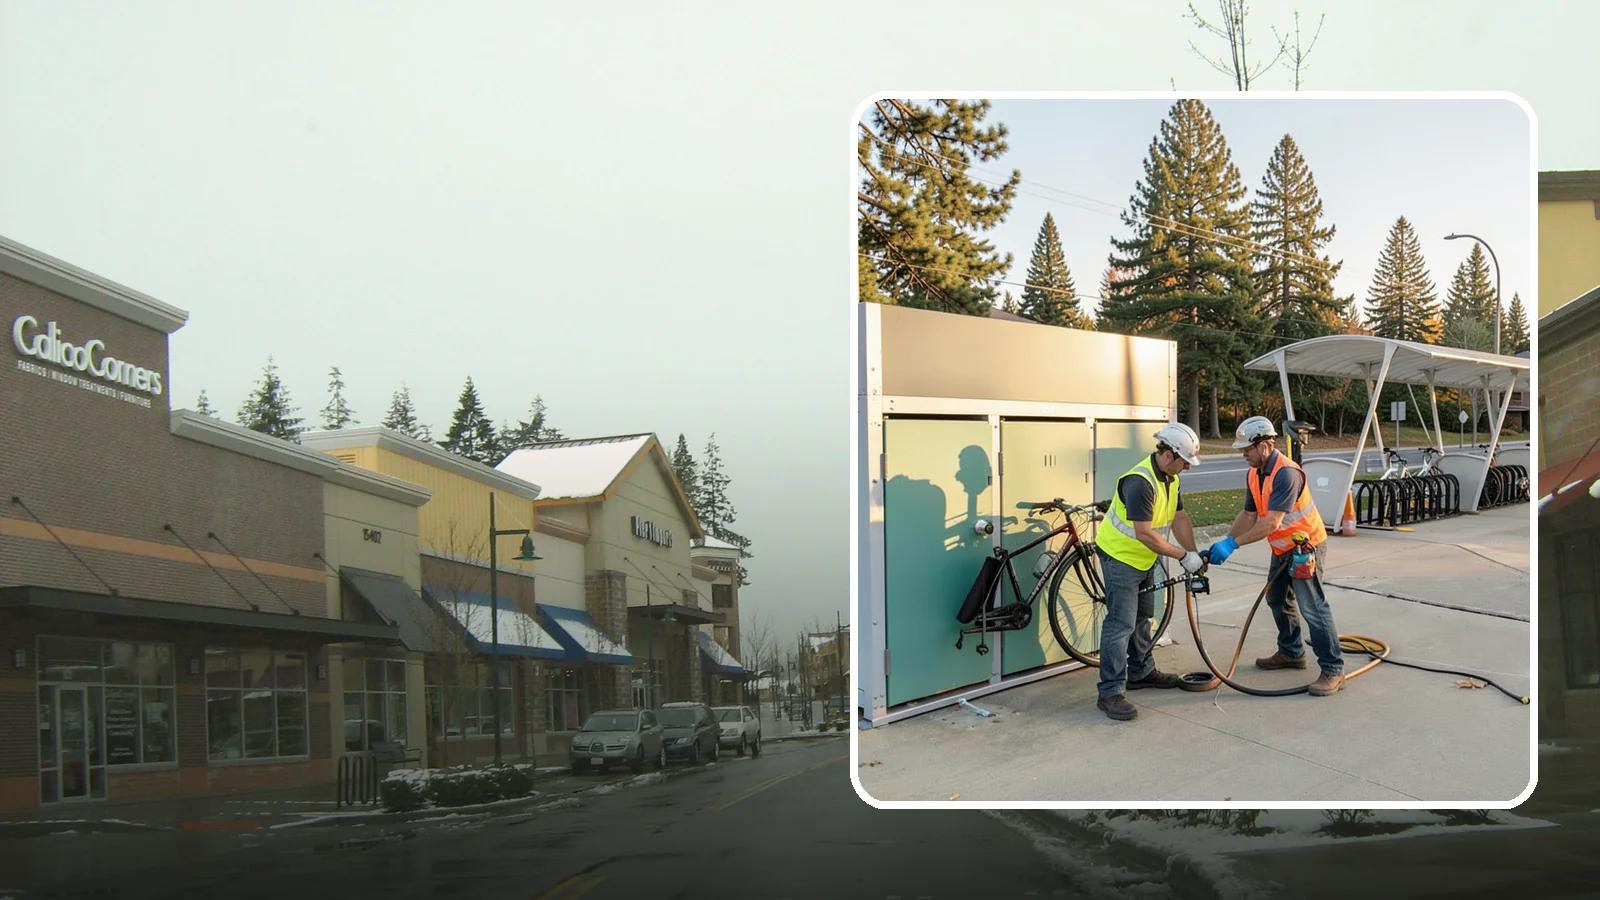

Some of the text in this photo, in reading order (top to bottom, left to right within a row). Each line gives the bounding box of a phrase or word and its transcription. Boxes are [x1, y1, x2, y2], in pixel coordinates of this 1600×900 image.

[17, 360, 151, 408] FABRICS WINDOW TREATMENTS FURNITURE
